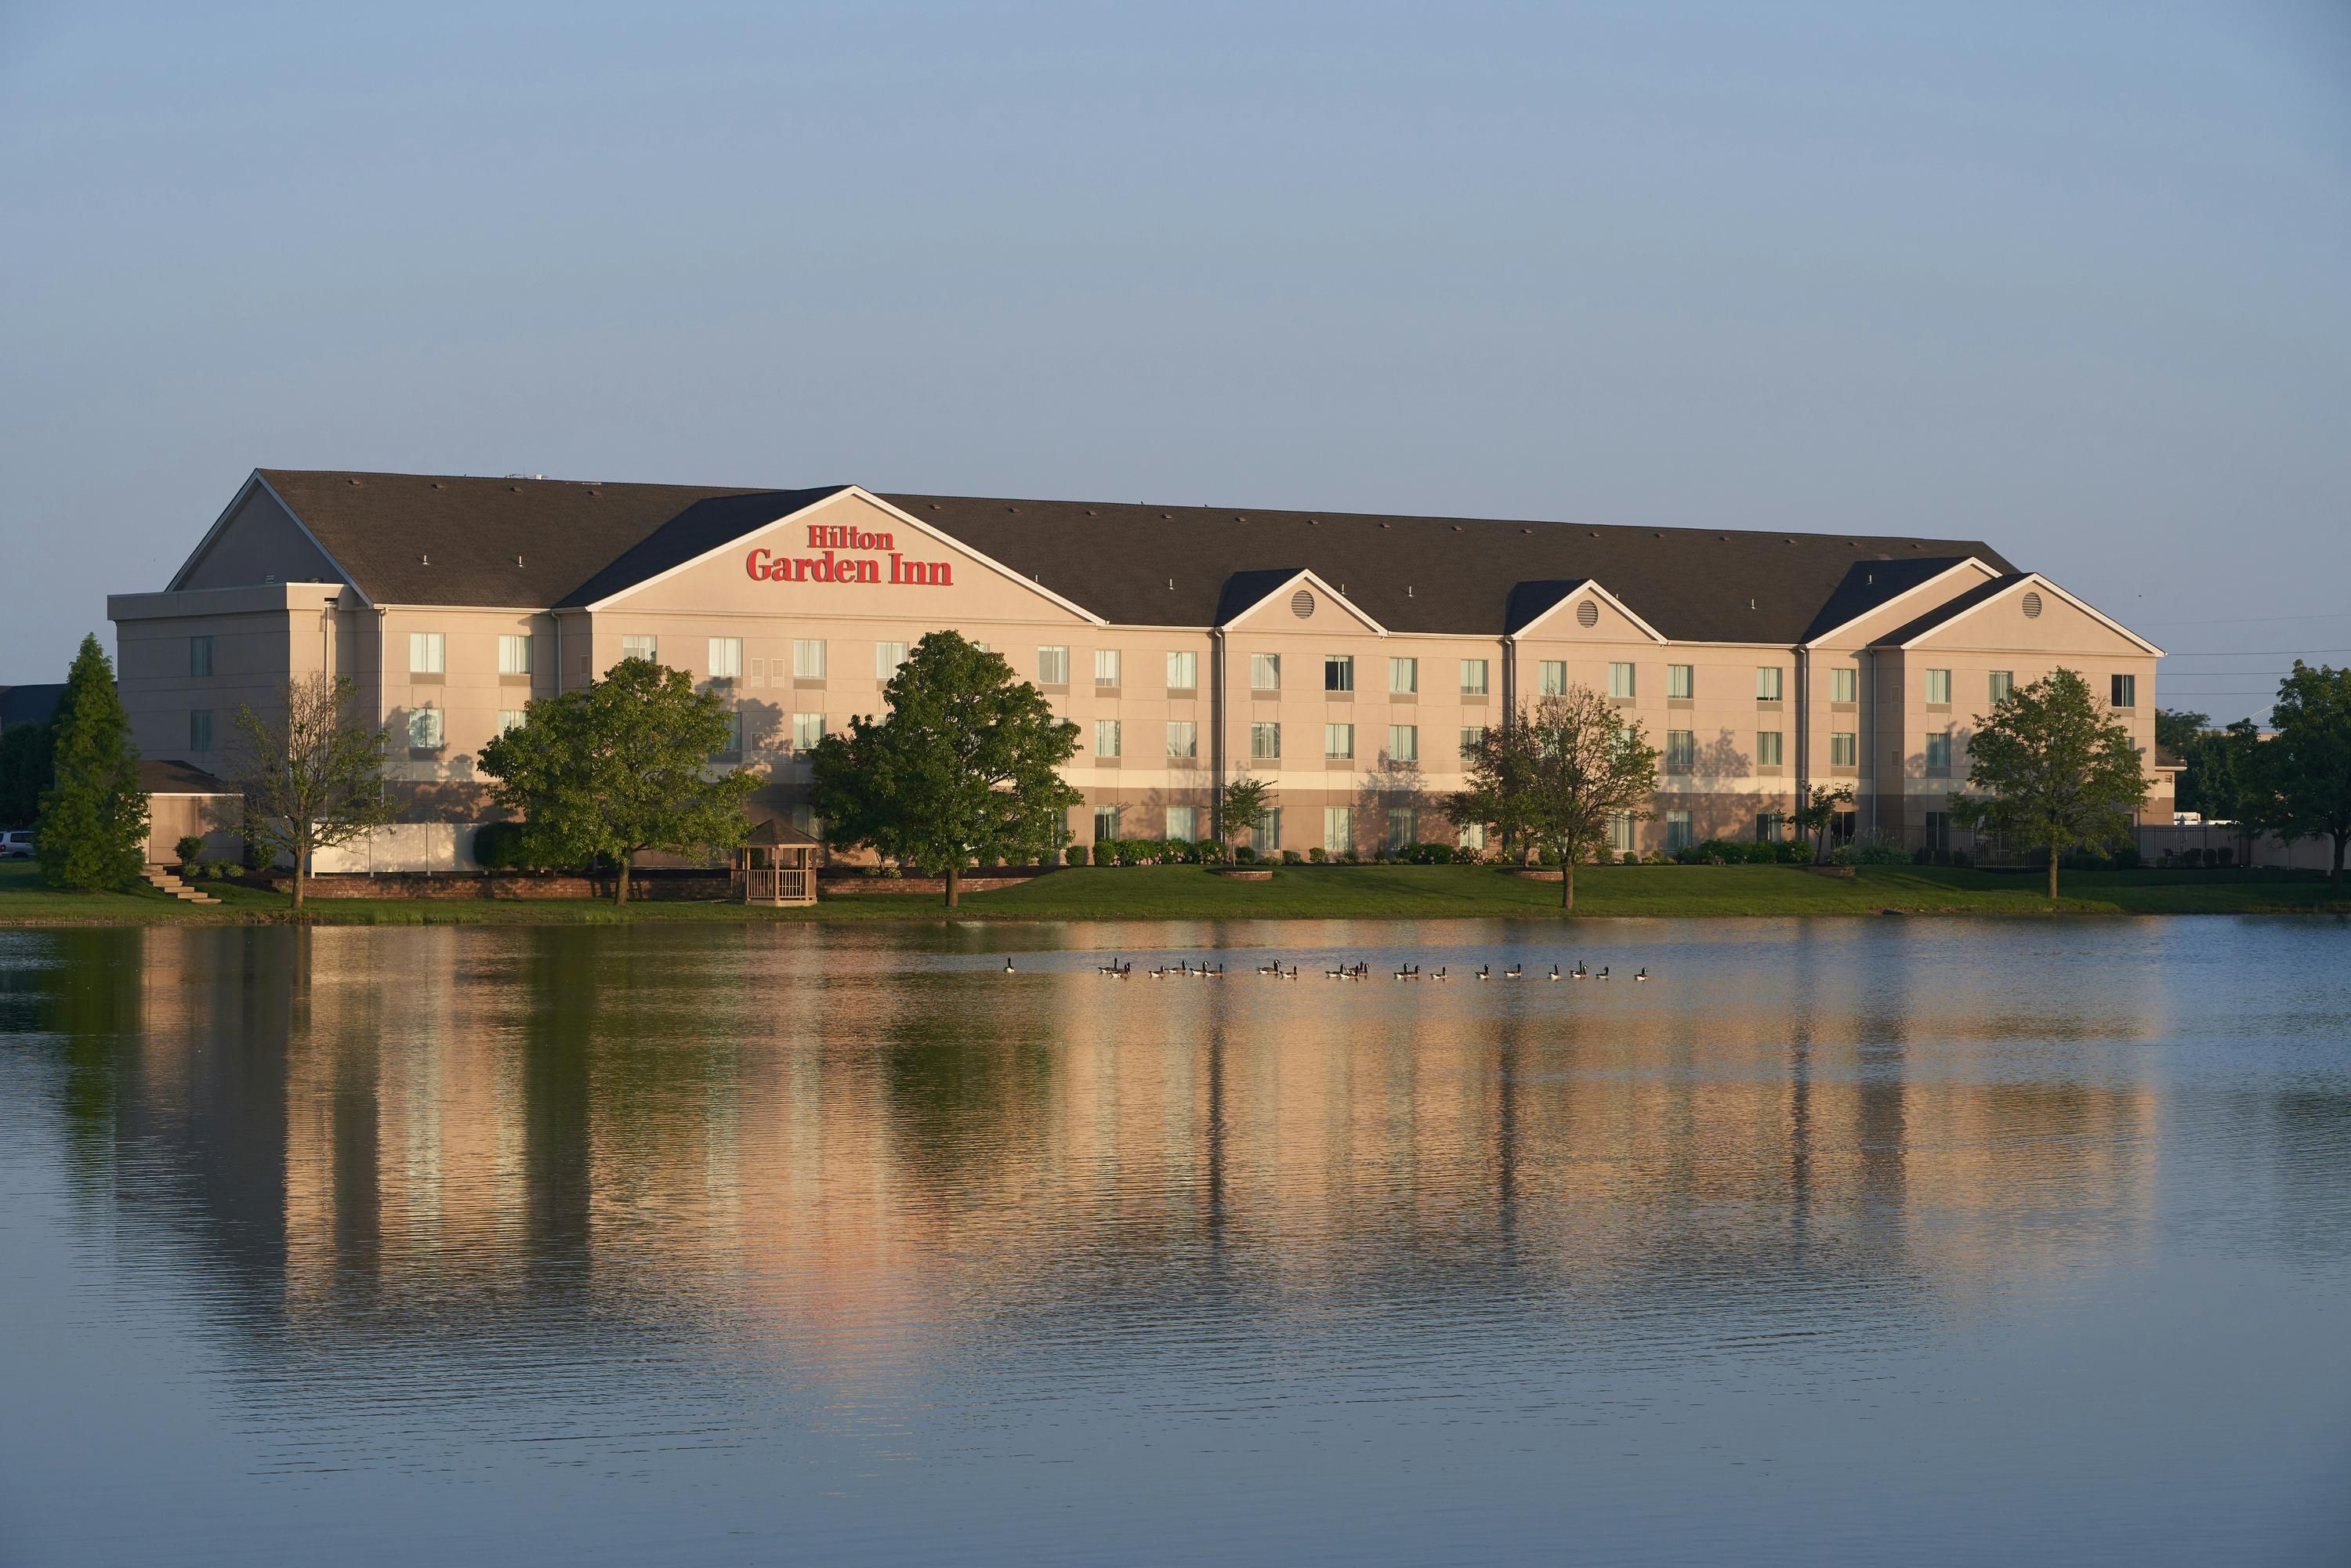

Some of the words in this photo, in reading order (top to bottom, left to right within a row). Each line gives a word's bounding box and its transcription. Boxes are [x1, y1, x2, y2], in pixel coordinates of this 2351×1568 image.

[807, 525, 894, 550] Hilton
[746, 548, 881, 584] Garden
[888, 552, 953, 586] Inn
